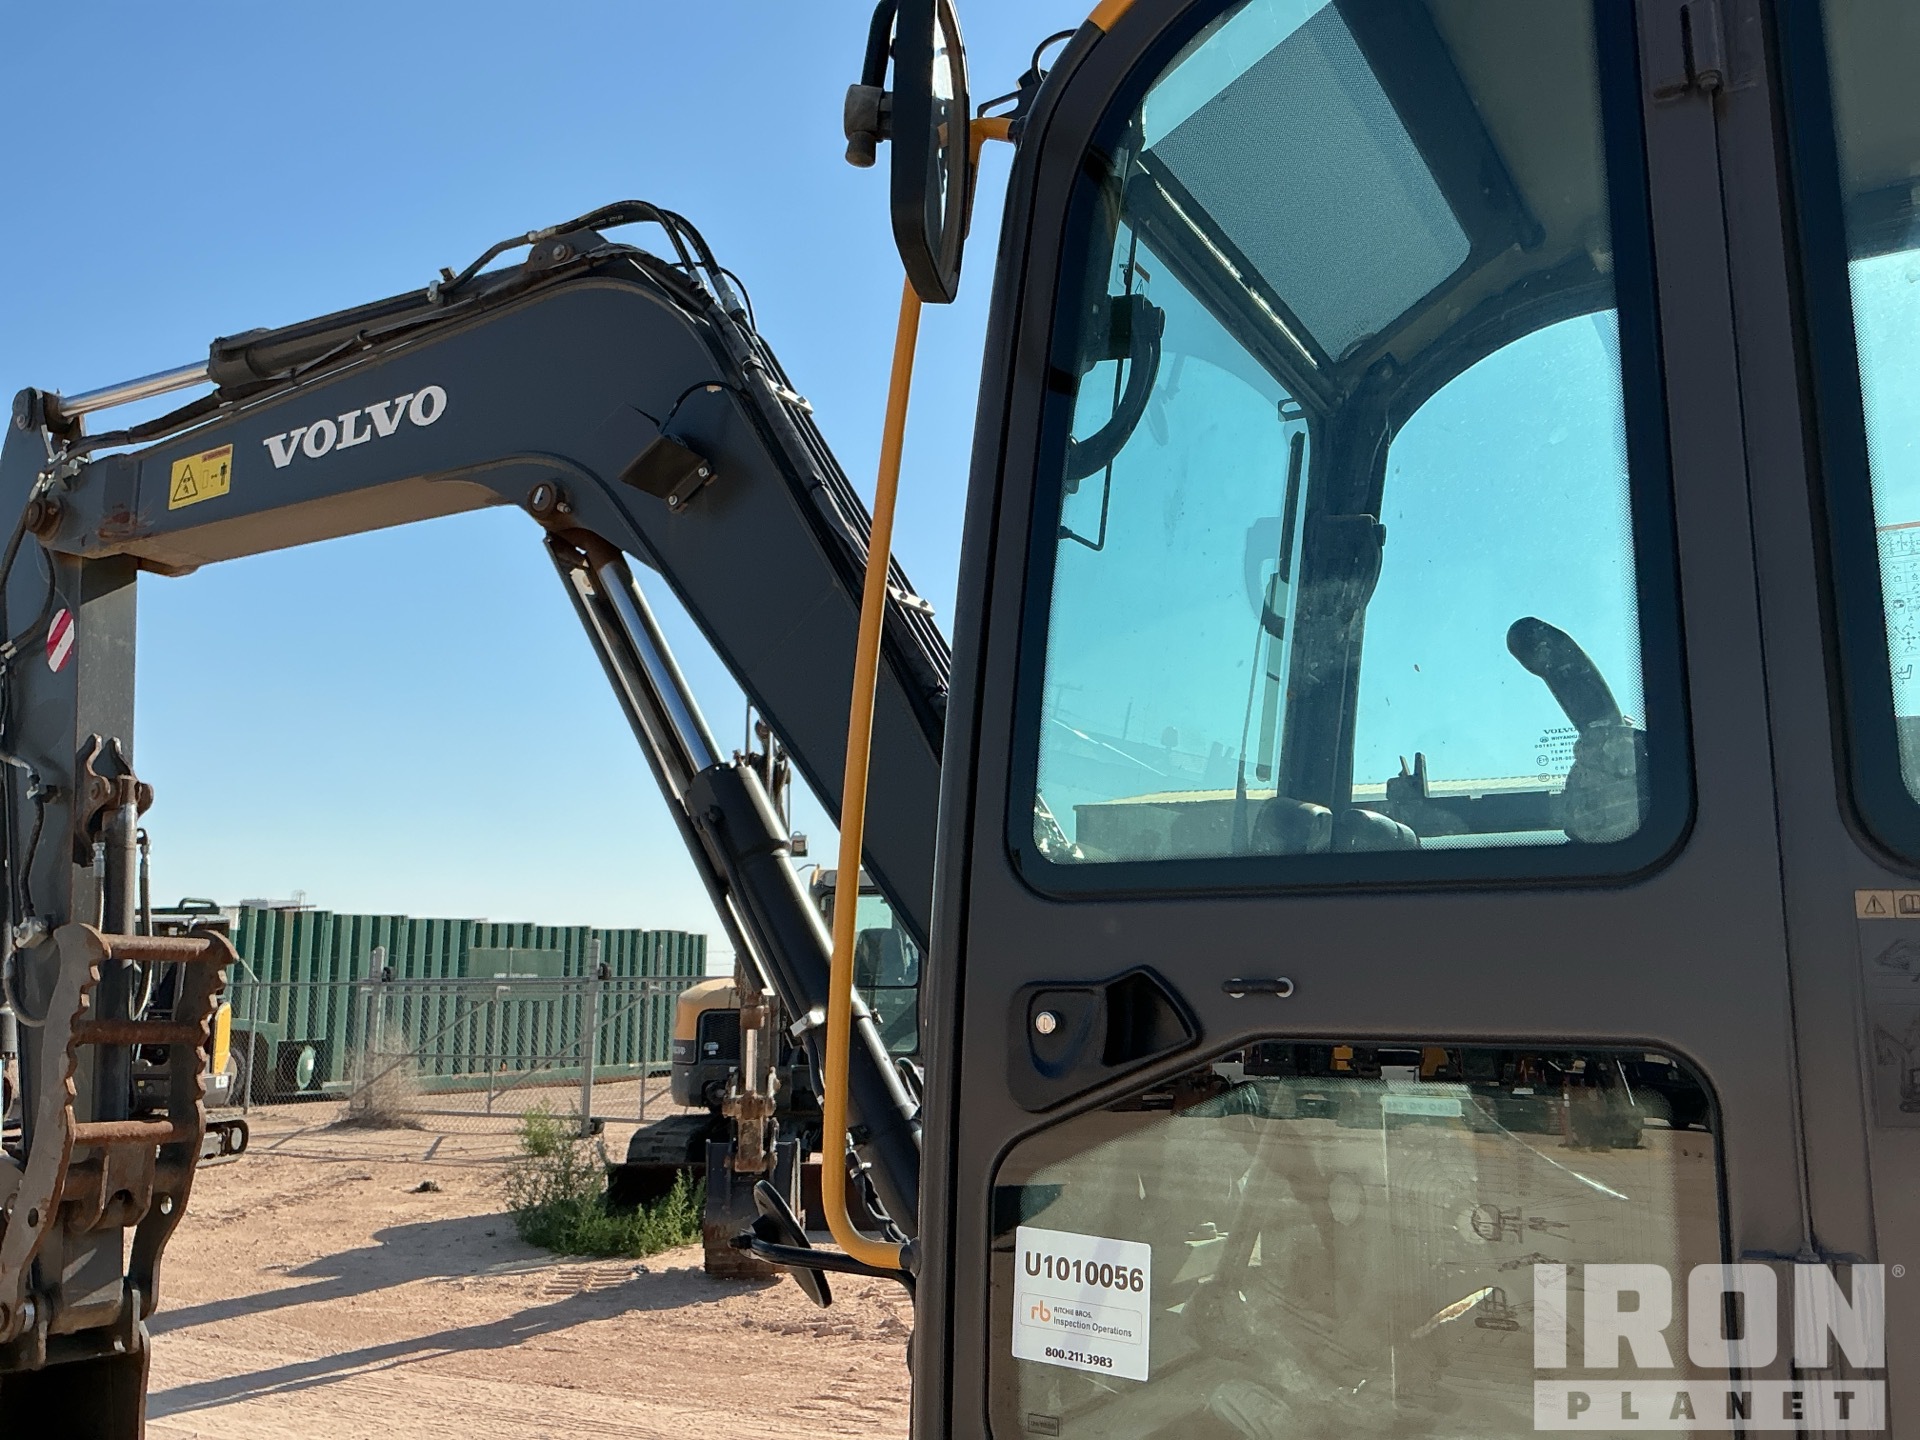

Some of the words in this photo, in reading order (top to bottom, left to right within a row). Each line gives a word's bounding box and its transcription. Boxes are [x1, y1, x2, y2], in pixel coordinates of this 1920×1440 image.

[263, 385, 448, 469] VOLVO
[1024, 1250, 1145, 1292] U1010056
[1053, 1306, 1075, 1315] RITCHIE
[1074, 1309, 1093, 1319] BROS.
[1053, 1316, 1091, 1331] Inspection
[1092, 1322, 1132, 1338] Operations
[1045, 1346, 1113, 1369] 800.211.3983
